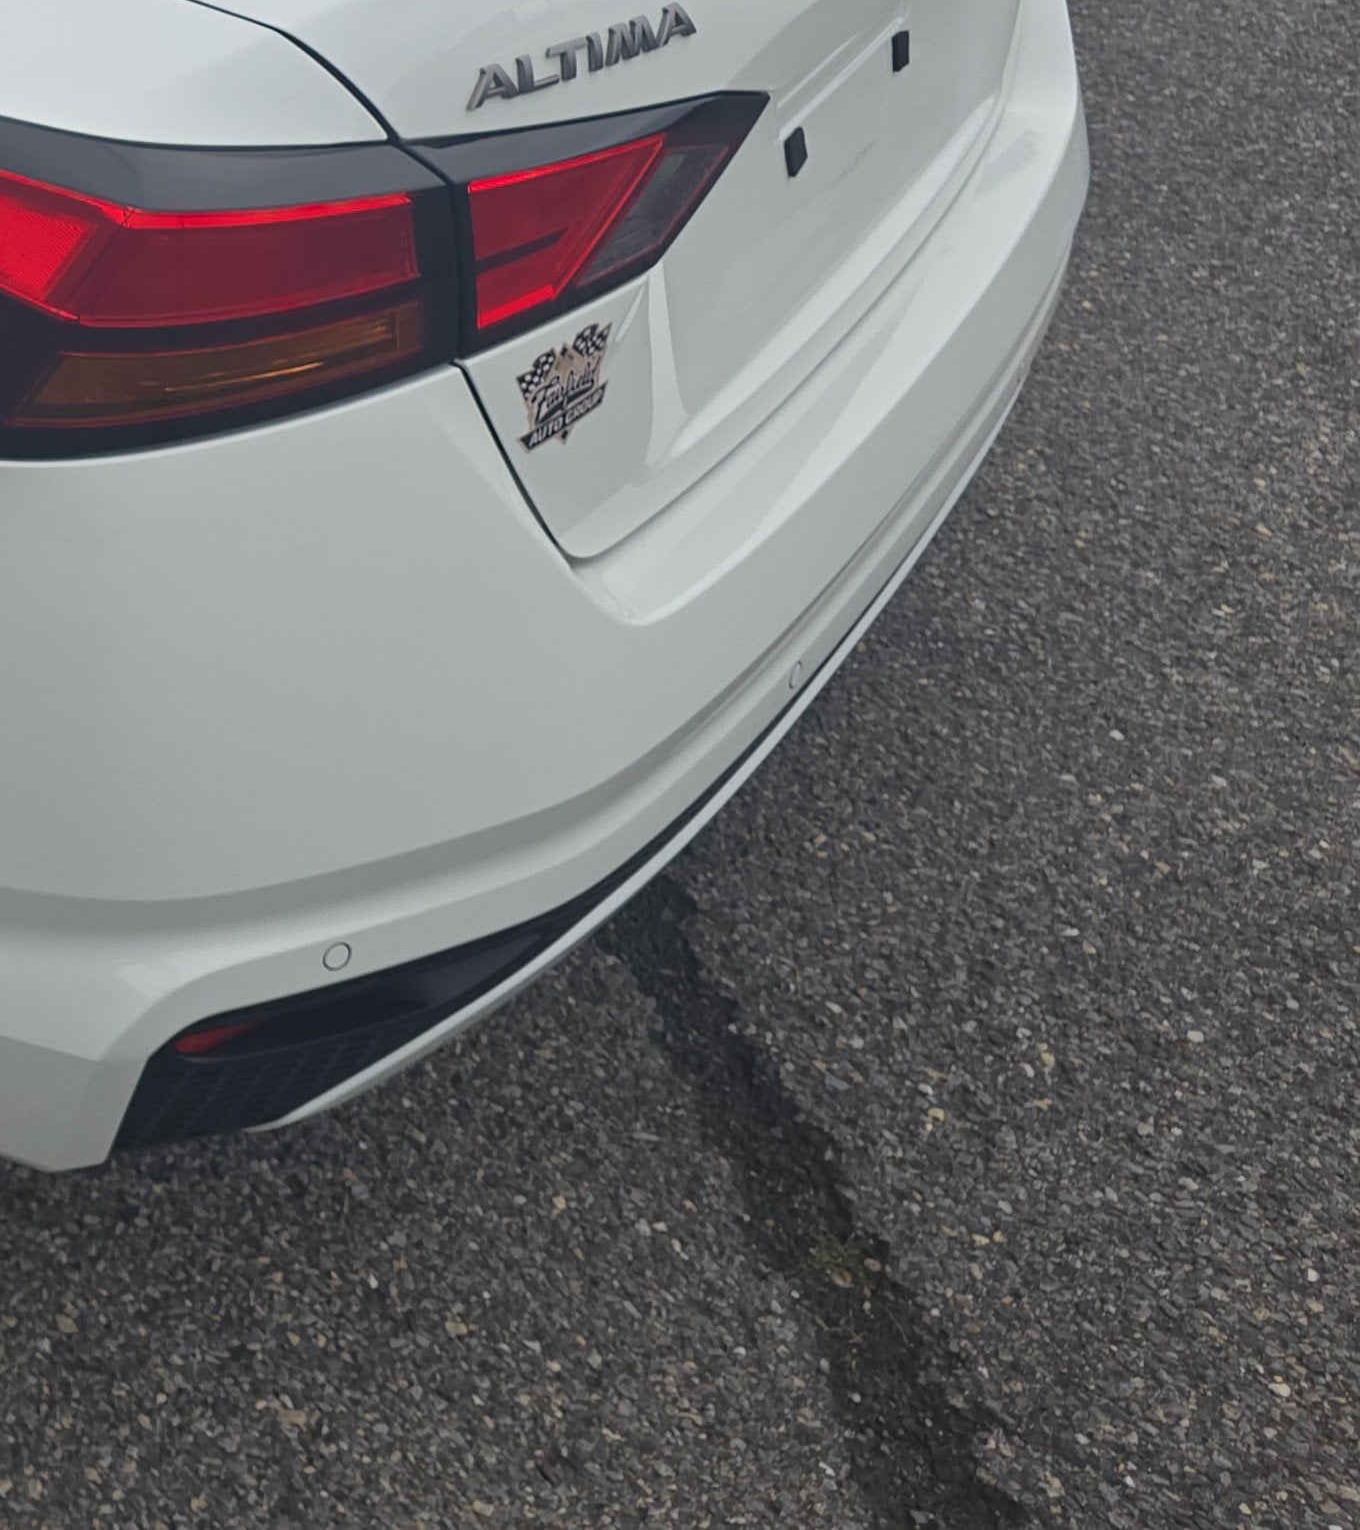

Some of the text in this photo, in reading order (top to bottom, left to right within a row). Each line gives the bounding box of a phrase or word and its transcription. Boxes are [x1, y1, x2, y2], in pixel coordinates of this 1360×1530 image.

[466, 2, 697, 110] ALTIMA
[528, 387, 603, 448] AUTO GROUP
